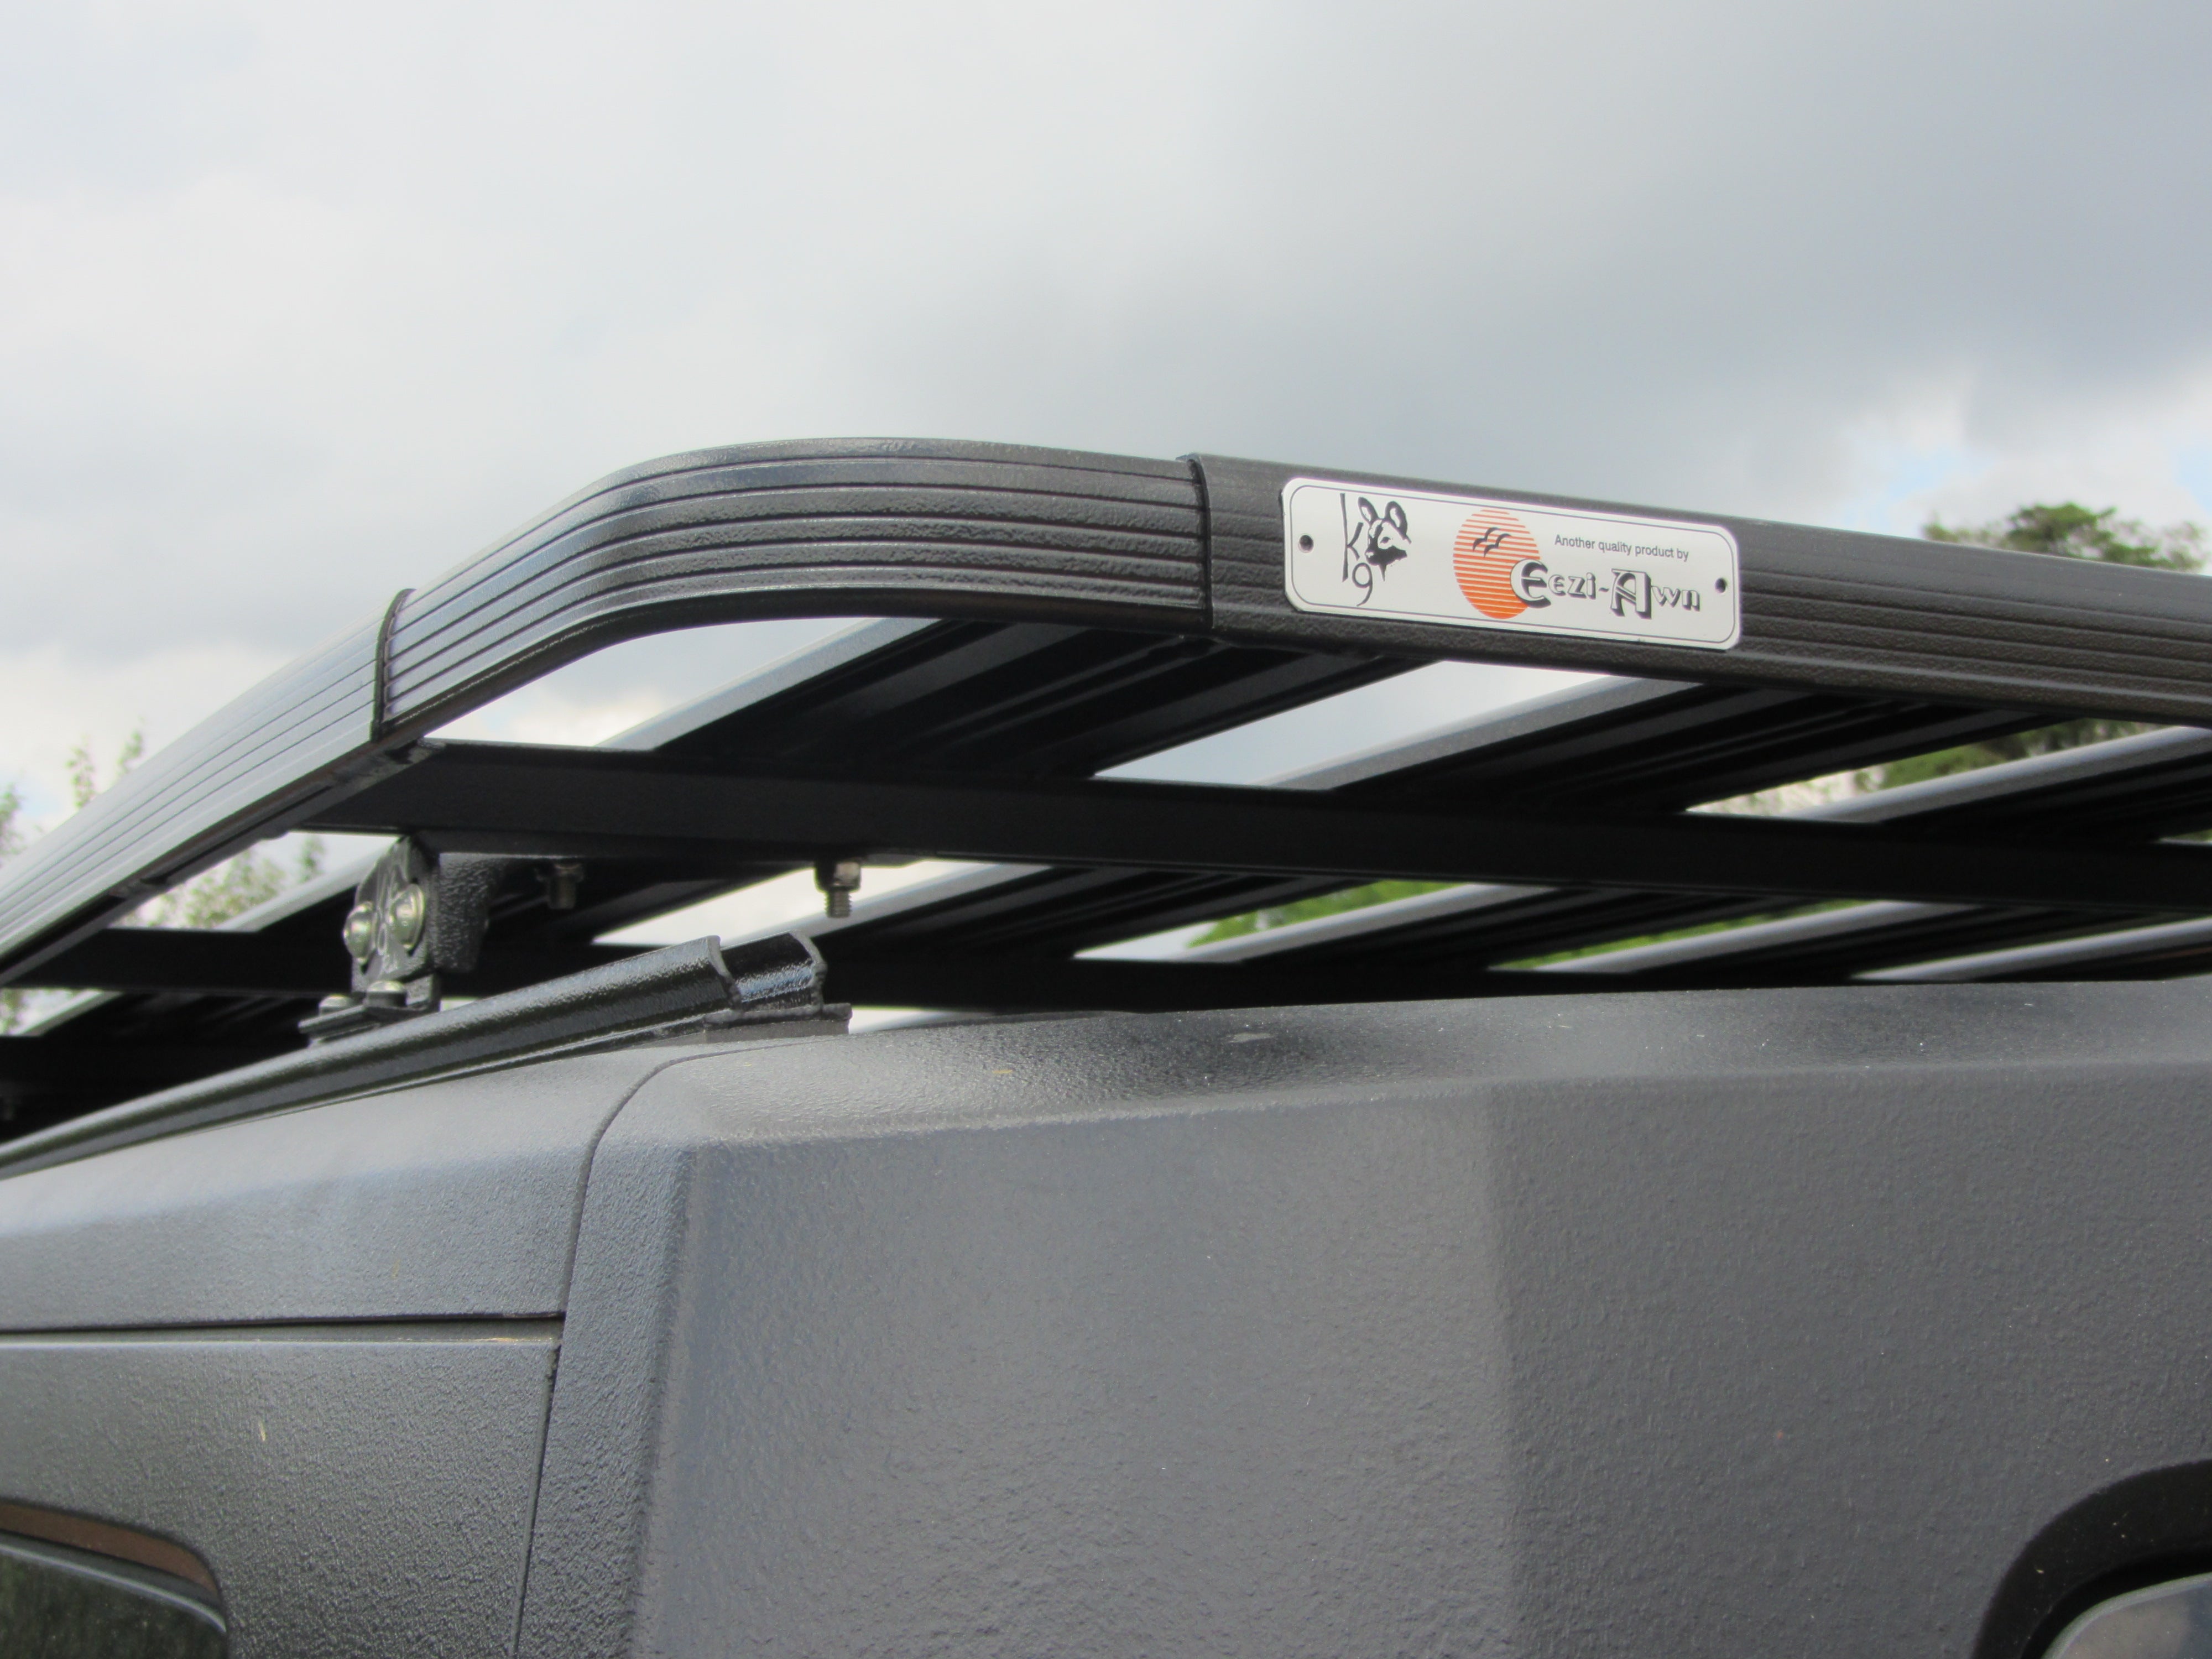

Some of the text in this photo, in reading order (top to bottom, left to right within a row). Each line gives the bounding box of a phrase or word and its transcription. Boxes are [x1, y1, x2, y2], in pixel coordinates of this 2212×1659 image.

[1554, 534, 1689, 562] Another quality product by
[1510, 559, 1700, 620] Eezi-Awn
